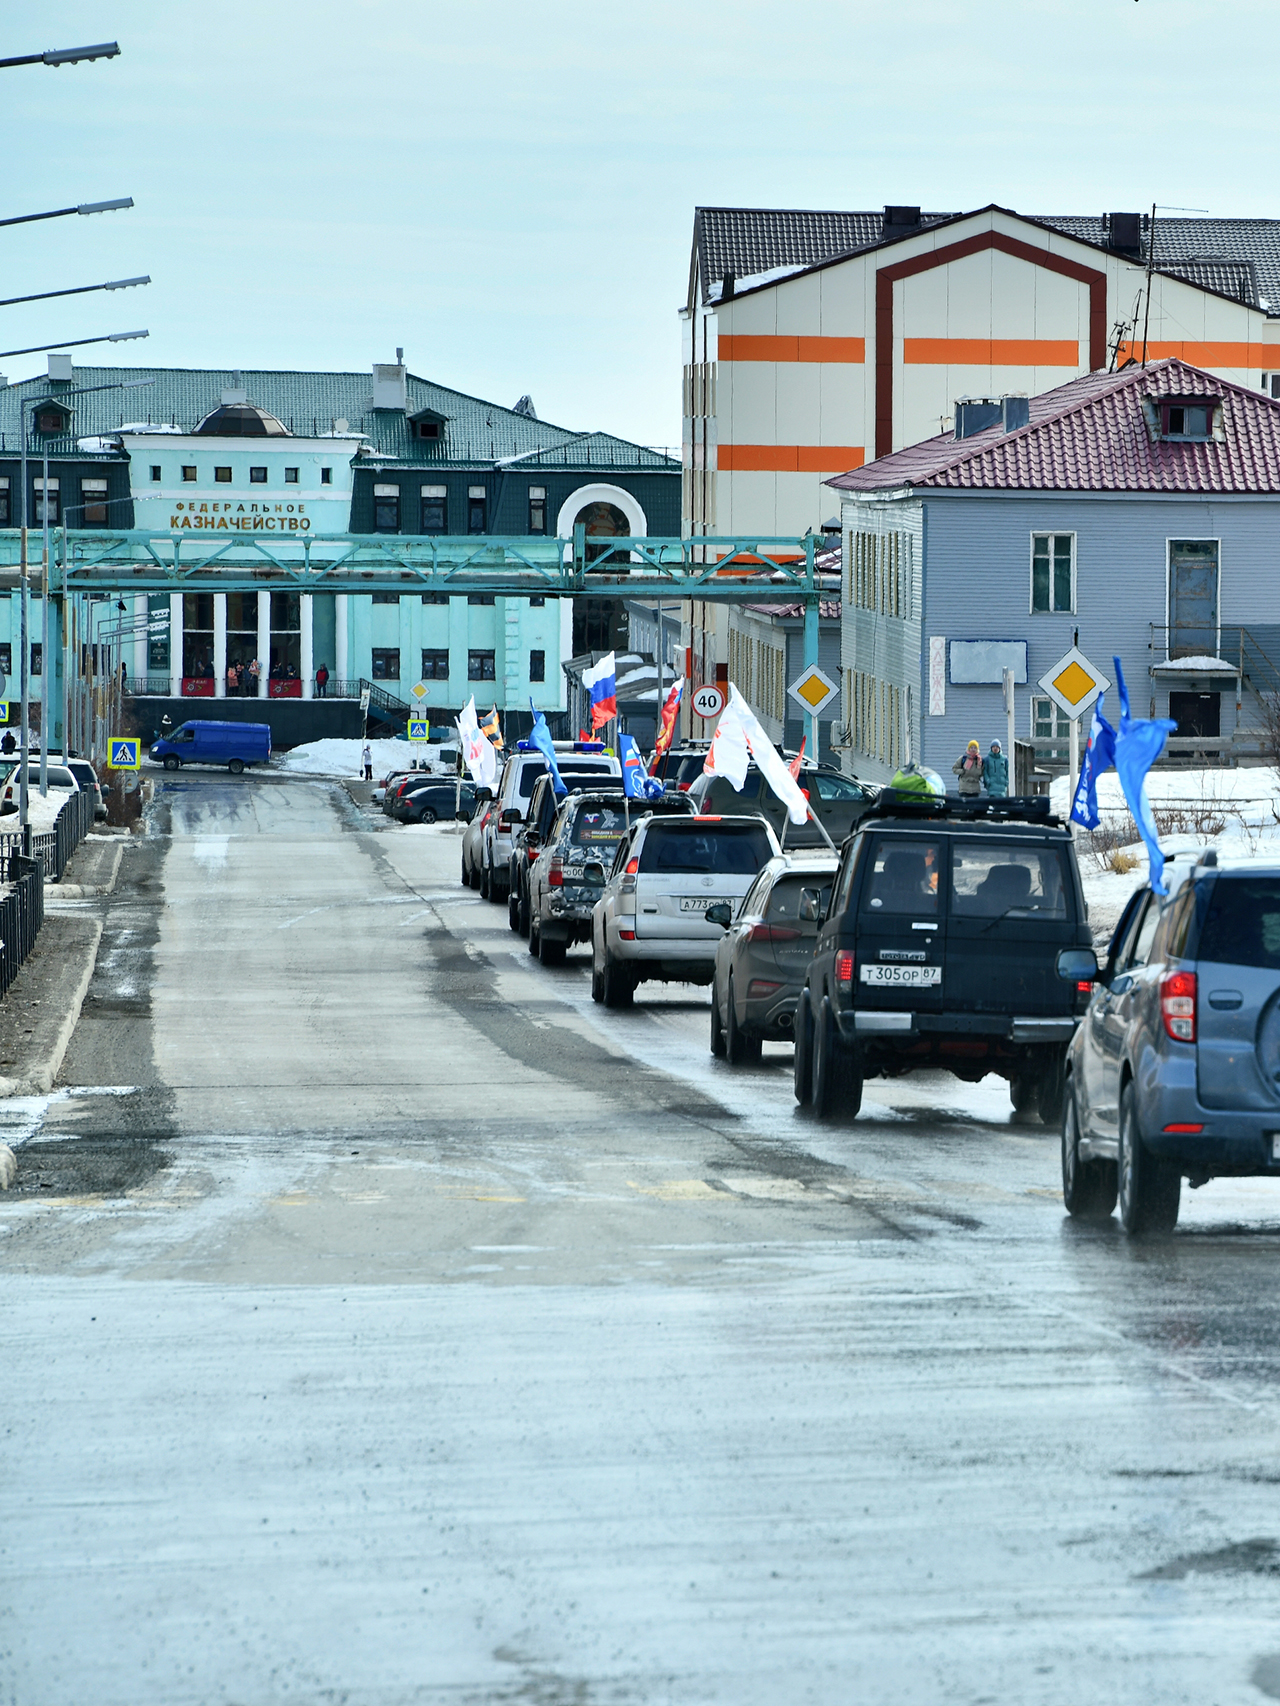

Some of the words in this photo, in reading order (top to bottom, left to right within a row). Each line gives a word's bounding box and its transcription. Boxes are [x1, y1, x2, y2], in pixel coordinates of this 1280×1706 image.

[175, 502, 305, 513] ФЕДЕРАЛЬНОЕ
[170, 513, 311, 531] КАЗНАЧЕЙСТВО
[930, 638, 945, 715] ОДЕЖДА
[697, 694, 717, 708] 40
[923, 968, 936, 978] 87
